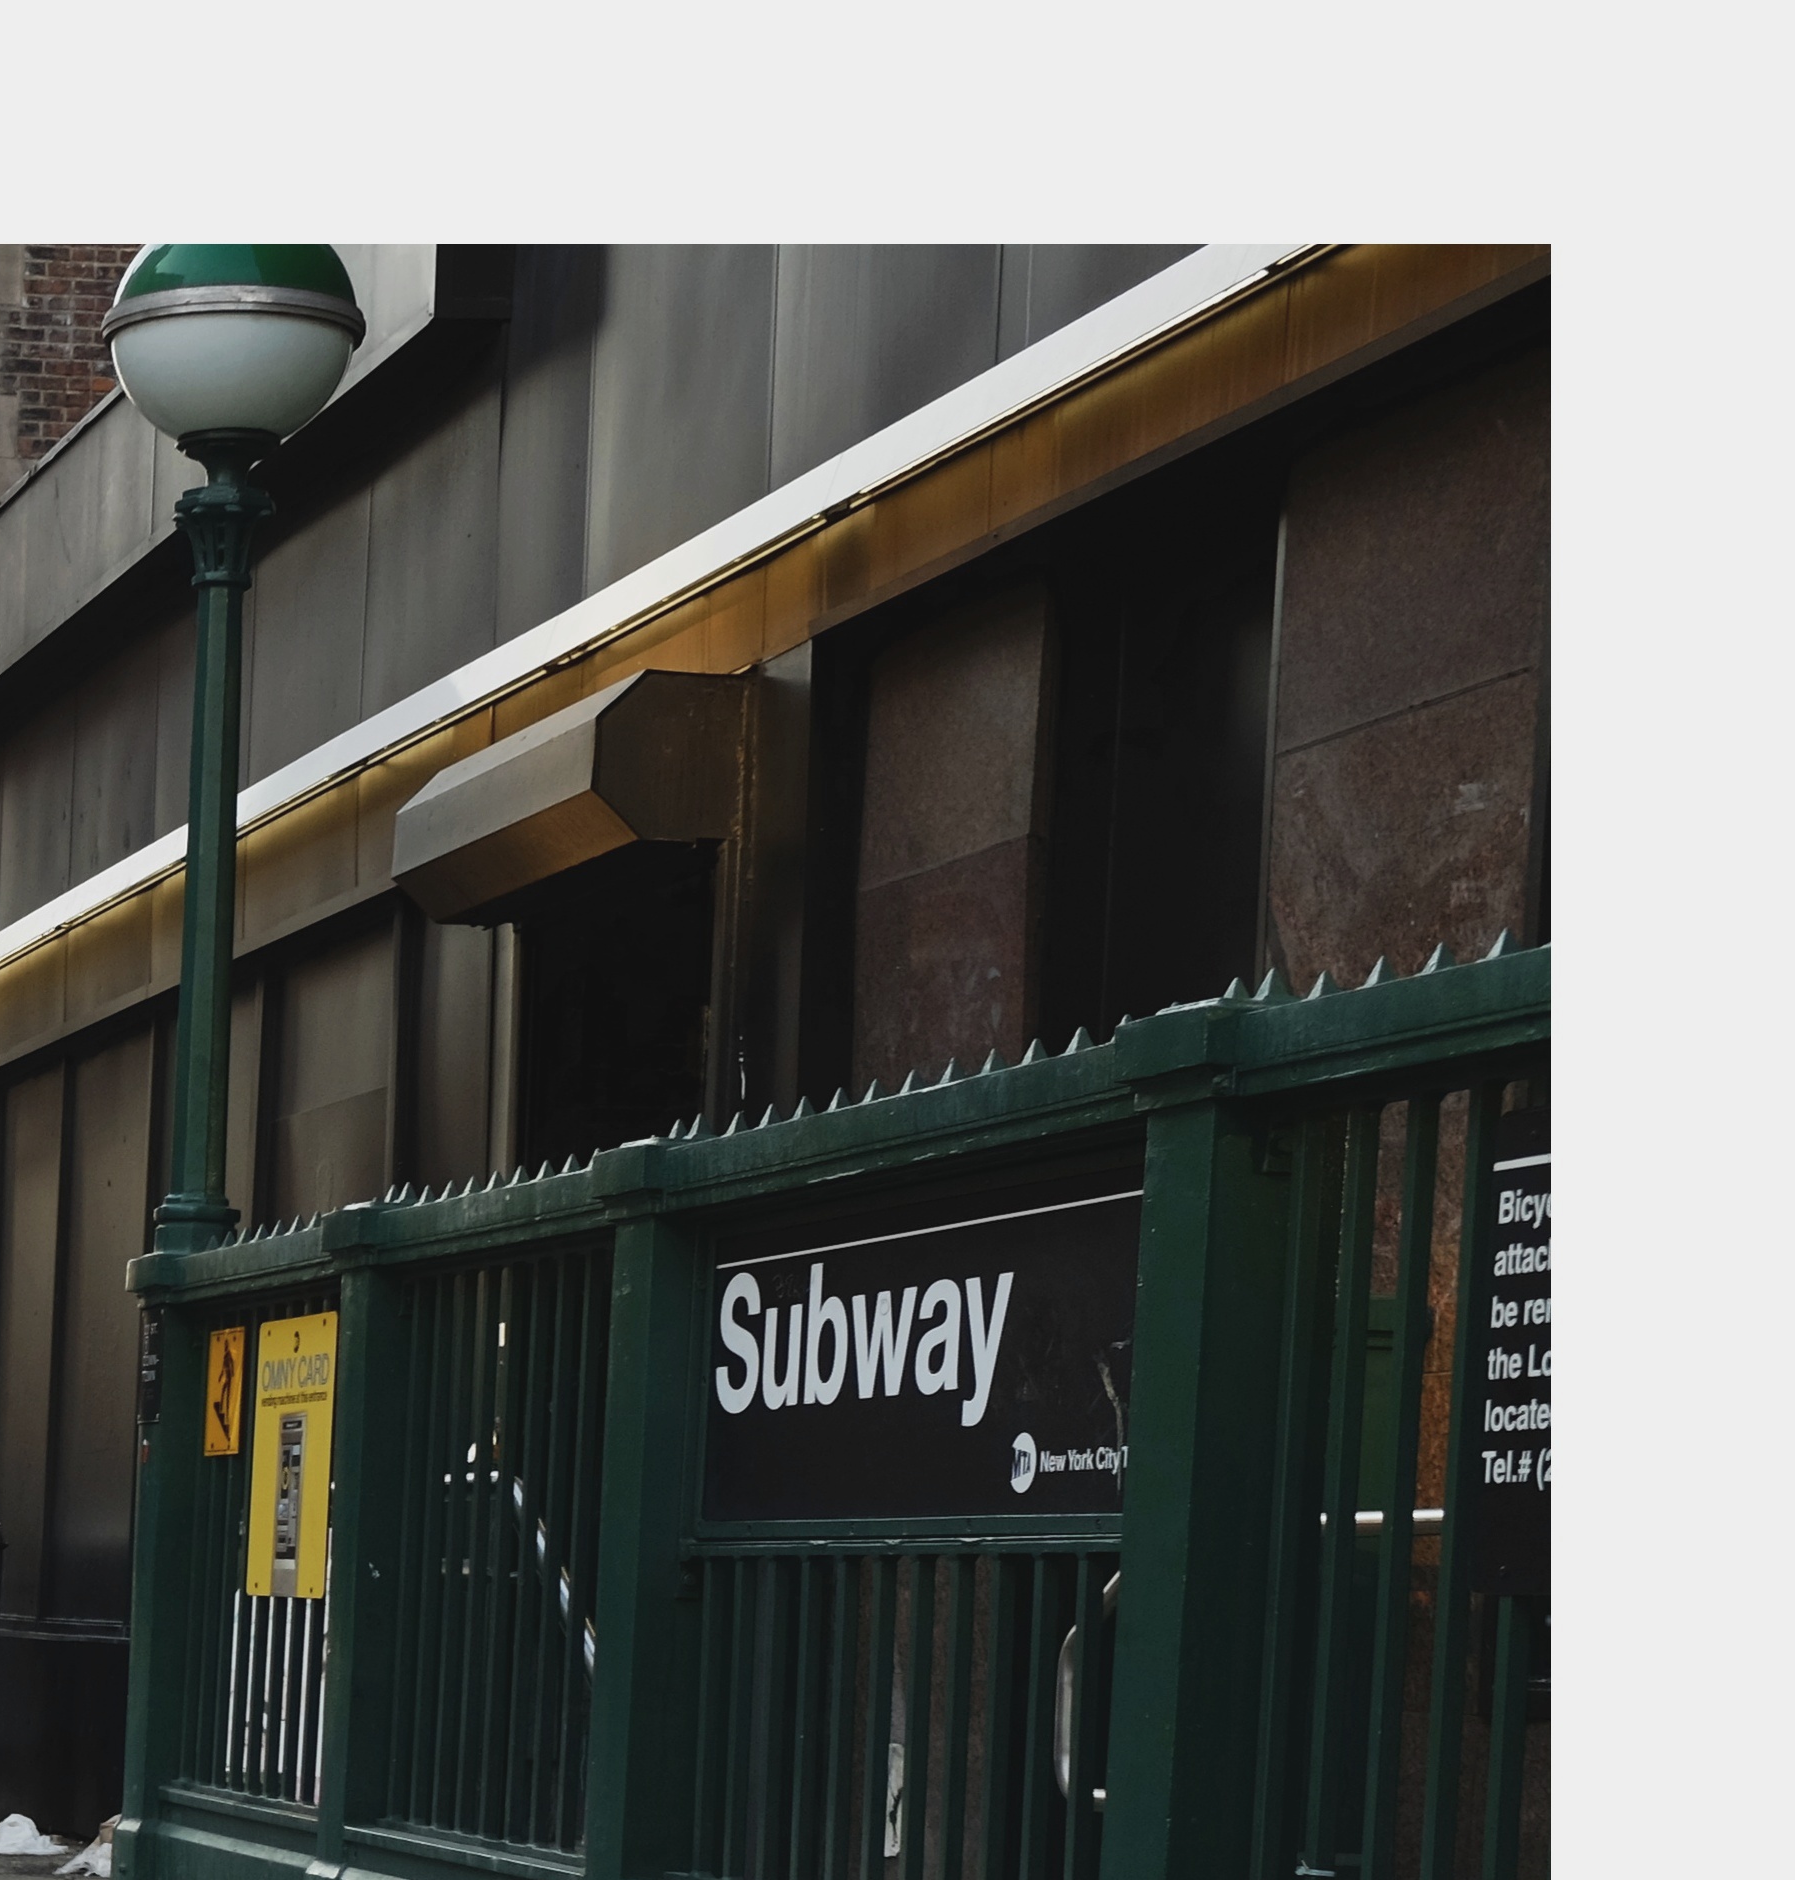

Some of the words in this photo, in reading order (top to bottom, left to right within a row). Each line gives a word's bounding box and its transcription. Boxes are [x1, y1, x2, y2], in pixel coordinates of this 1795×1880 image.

[1490, 1295, 1518, 1328] be
[715, 1262, 1014, 1427] Subway
[262, 1357, 297, 1392] OMNY
[297, 1353, 329, 1388] CARD
[1487, 1347, 1522, 1380] the
[1484, 1398, 1551, 1432] locate
[1040, 1450, 1067, 1473] New
[1067, 1448, 1094, 1470] York
[1095, 1446, 1121, 1475] City
